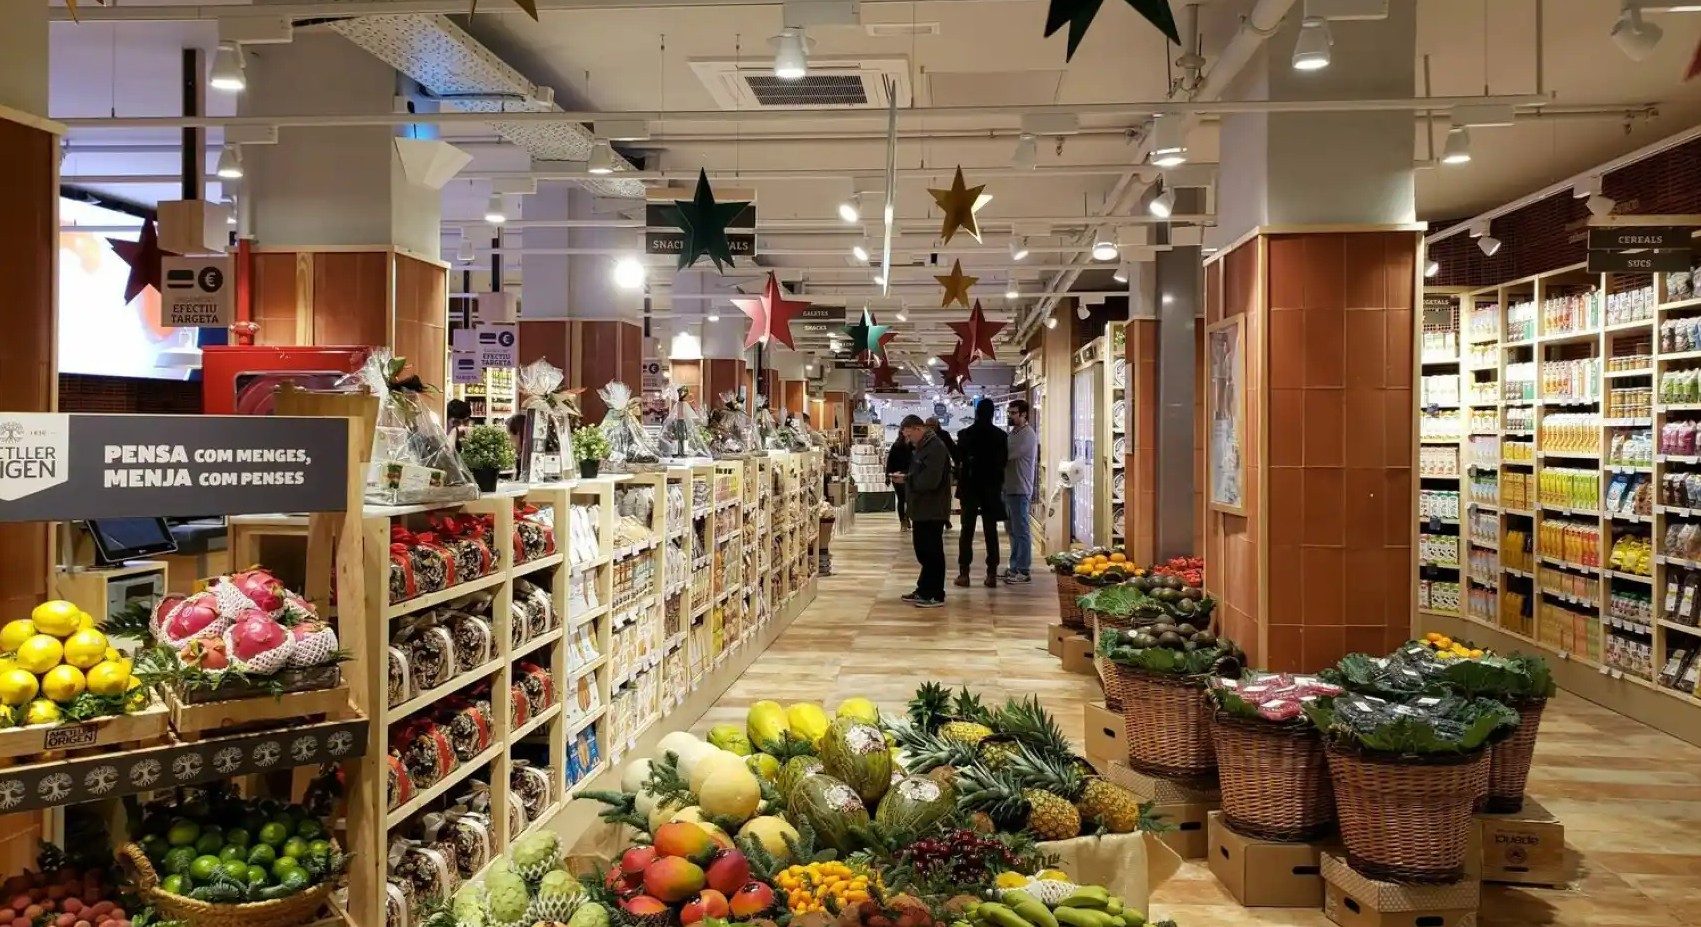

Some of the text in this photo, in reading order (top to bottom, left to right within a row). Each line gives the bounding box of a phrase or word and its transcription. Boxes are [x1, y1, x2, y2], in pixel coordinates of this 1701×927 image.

[1618, 235, 1663, 244] CEREALS
[1627, 259, 1651, 268] SUCS
[173, 304, 217, 313] EFECTIU
[171, 314, 219, 323] TARGETA
[104, 445, 312, 465] PENSA COM MENGES,
[104, 468, 305, 488] MENJA COM PENSES
[49, 731, 93, 747] ORIGEN
